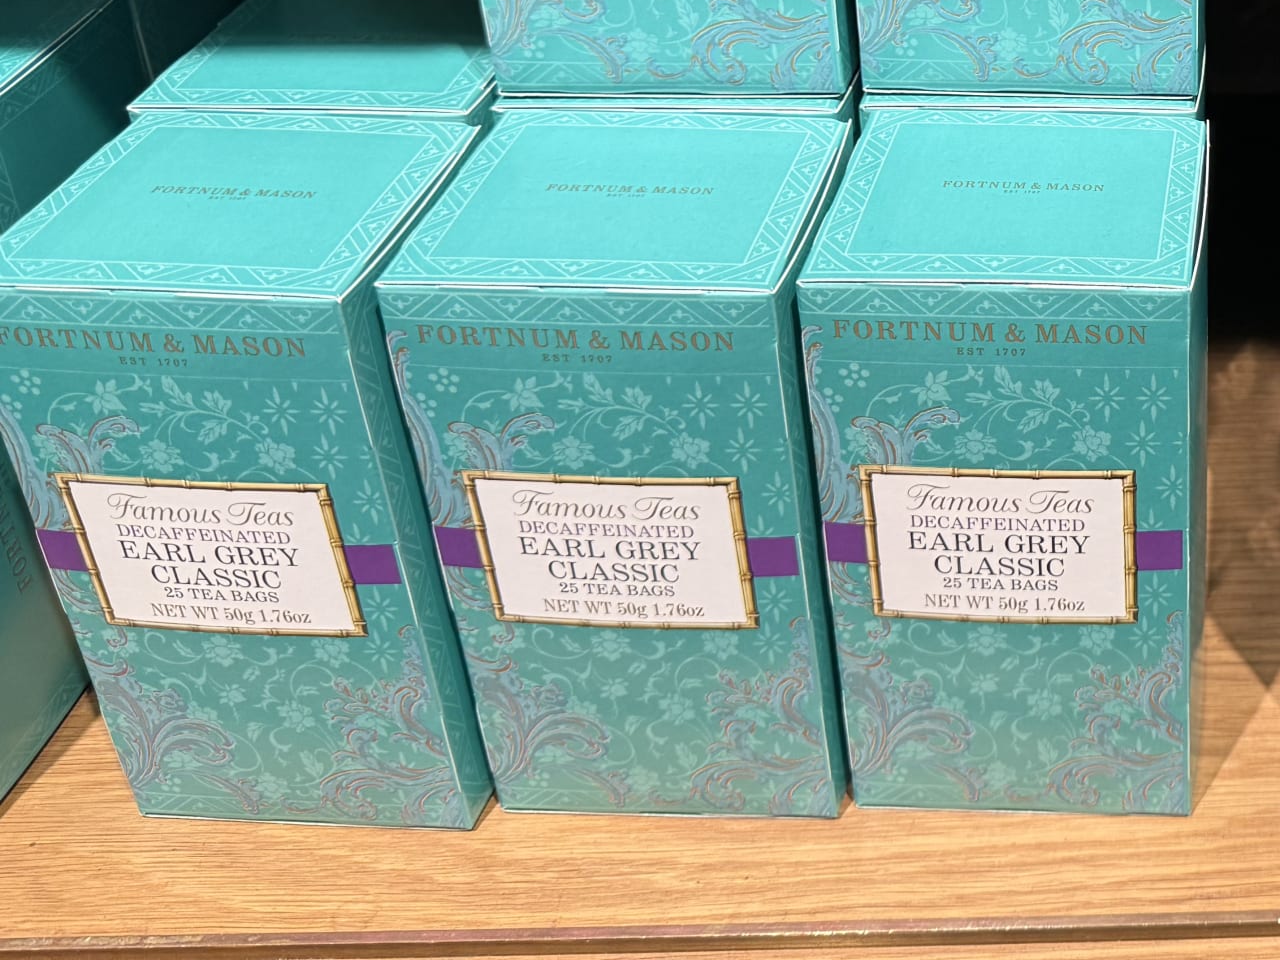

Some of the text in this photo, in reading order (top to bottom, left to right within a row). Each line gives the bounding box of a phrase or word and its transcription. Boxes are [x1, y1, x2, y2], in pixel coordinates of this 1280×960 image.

[942, 180, 1105, 191] FORTNUM & MASON
[416, 325, 734, 352] FORTNUM & MASON
[832, 320, 1148, 344] FORTNUM & MASON
[163, 333, 184, 353] &
[193, 335, 306, 357] MASON
[956, 347, 985, 356] EST
[119, 356, 147, 366] EST
[107, 493, 293, 526] Famous Teas
[512, 490, 699, 521] Famous Teas
[907, 484, 1094, 514] Famous Teas
[116, 524, 291, 544] DECAFFEINATED
[519, 520, 694, 539] DECAFFEINATED
[911, 515, 1085, 532] DECAFFEINATED
[117, 540, 298, 566] EARL GREY
[518, 536, 700, 560] EARL GREY
[908, 531, 1090, 554] EARL GREY
[151, 564, 281, 589] CLASSIC
[548, 560, 679, 583] CLASSIC
[934, 555, 1064, 577] CLASSIC
[164, 586, 279, 603] 25 TEA BAGS
[559, 582, 675, 597] 25 TEA BAGS
[943, 577, 1058, 591] 25 TEA BAGS
[151, 603, 312, 625] NET WT 50g 1.76oz
[543, 598, 705, 619] NET WT 50g 1.76oz
[925, 593, 1085, 614] NET WT 50g 1.76oz
